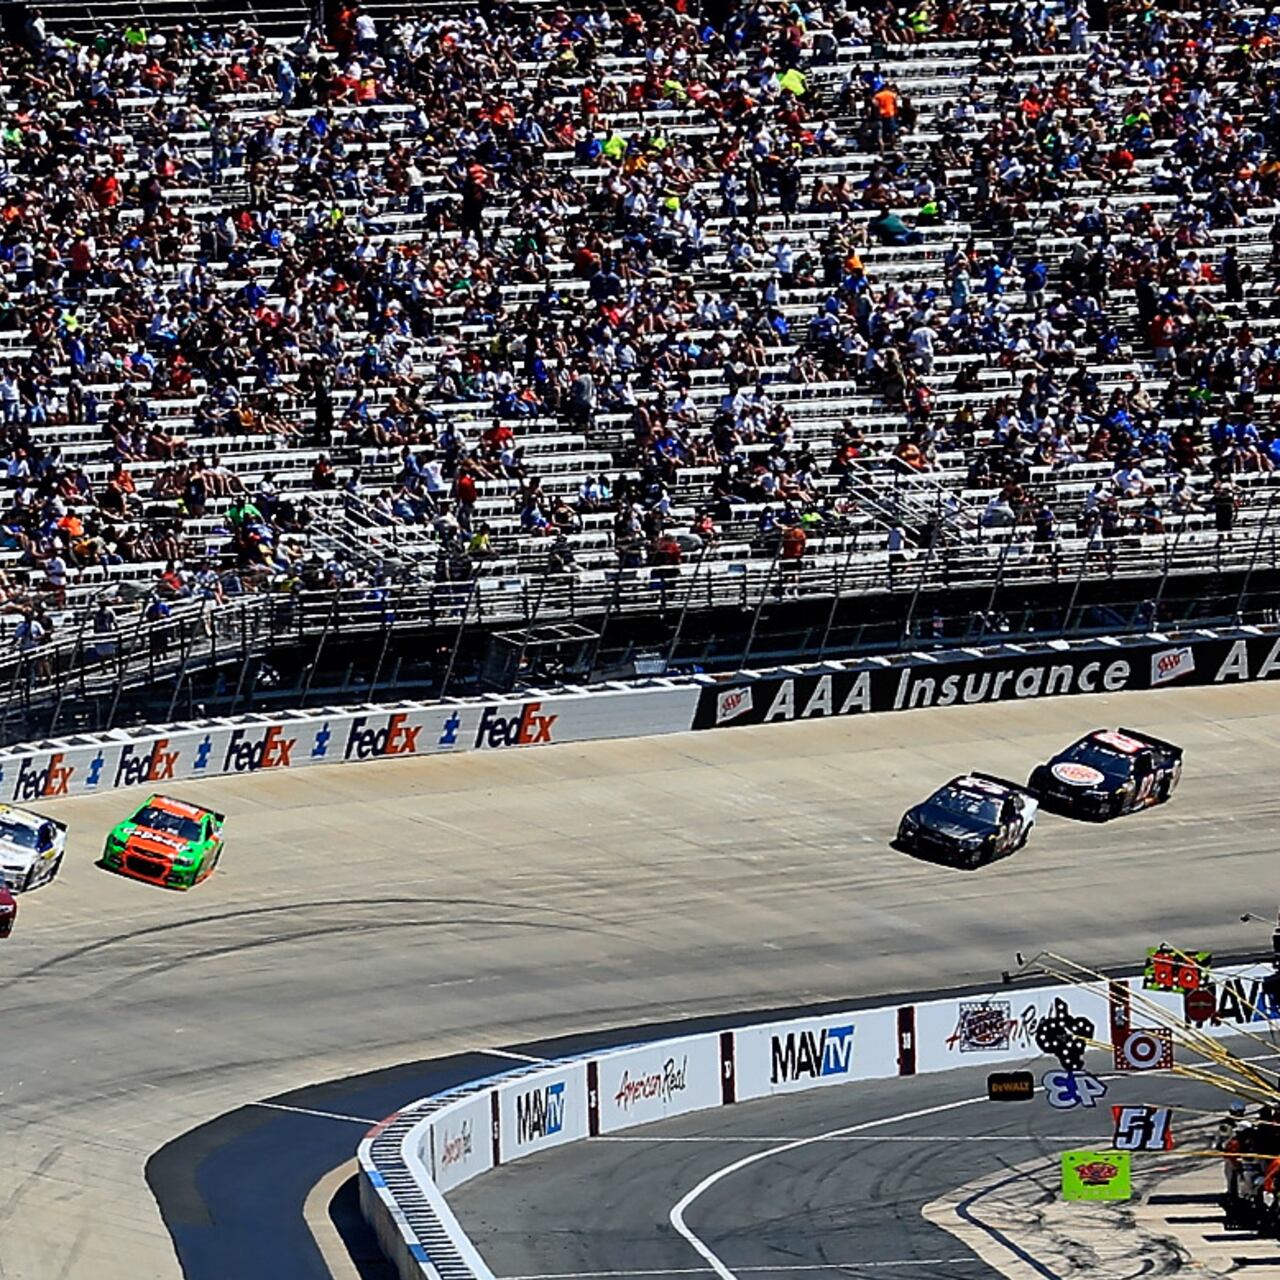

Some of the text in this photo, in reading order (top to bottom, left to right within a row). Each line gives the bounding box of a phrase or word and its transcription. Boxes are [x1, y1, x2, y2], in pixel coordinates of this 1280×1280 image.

[763, 659, 1131, 722] AAA Insurance
[223, 726, 297, 772] FedEx
[344, 713, 423, 759] FedEx
[474, 702, 559, 749] FedEx
[13, 753, 75, 800] FedEx
[114, 738, 180, 788] FedEx
[770, 1024, 855, 1084] MAVTV
[662, 1055, 687, 1103] Real
[517, 1081, 566, 1145] MAVTV
[1116, 1107, 1168, 1150] 51
